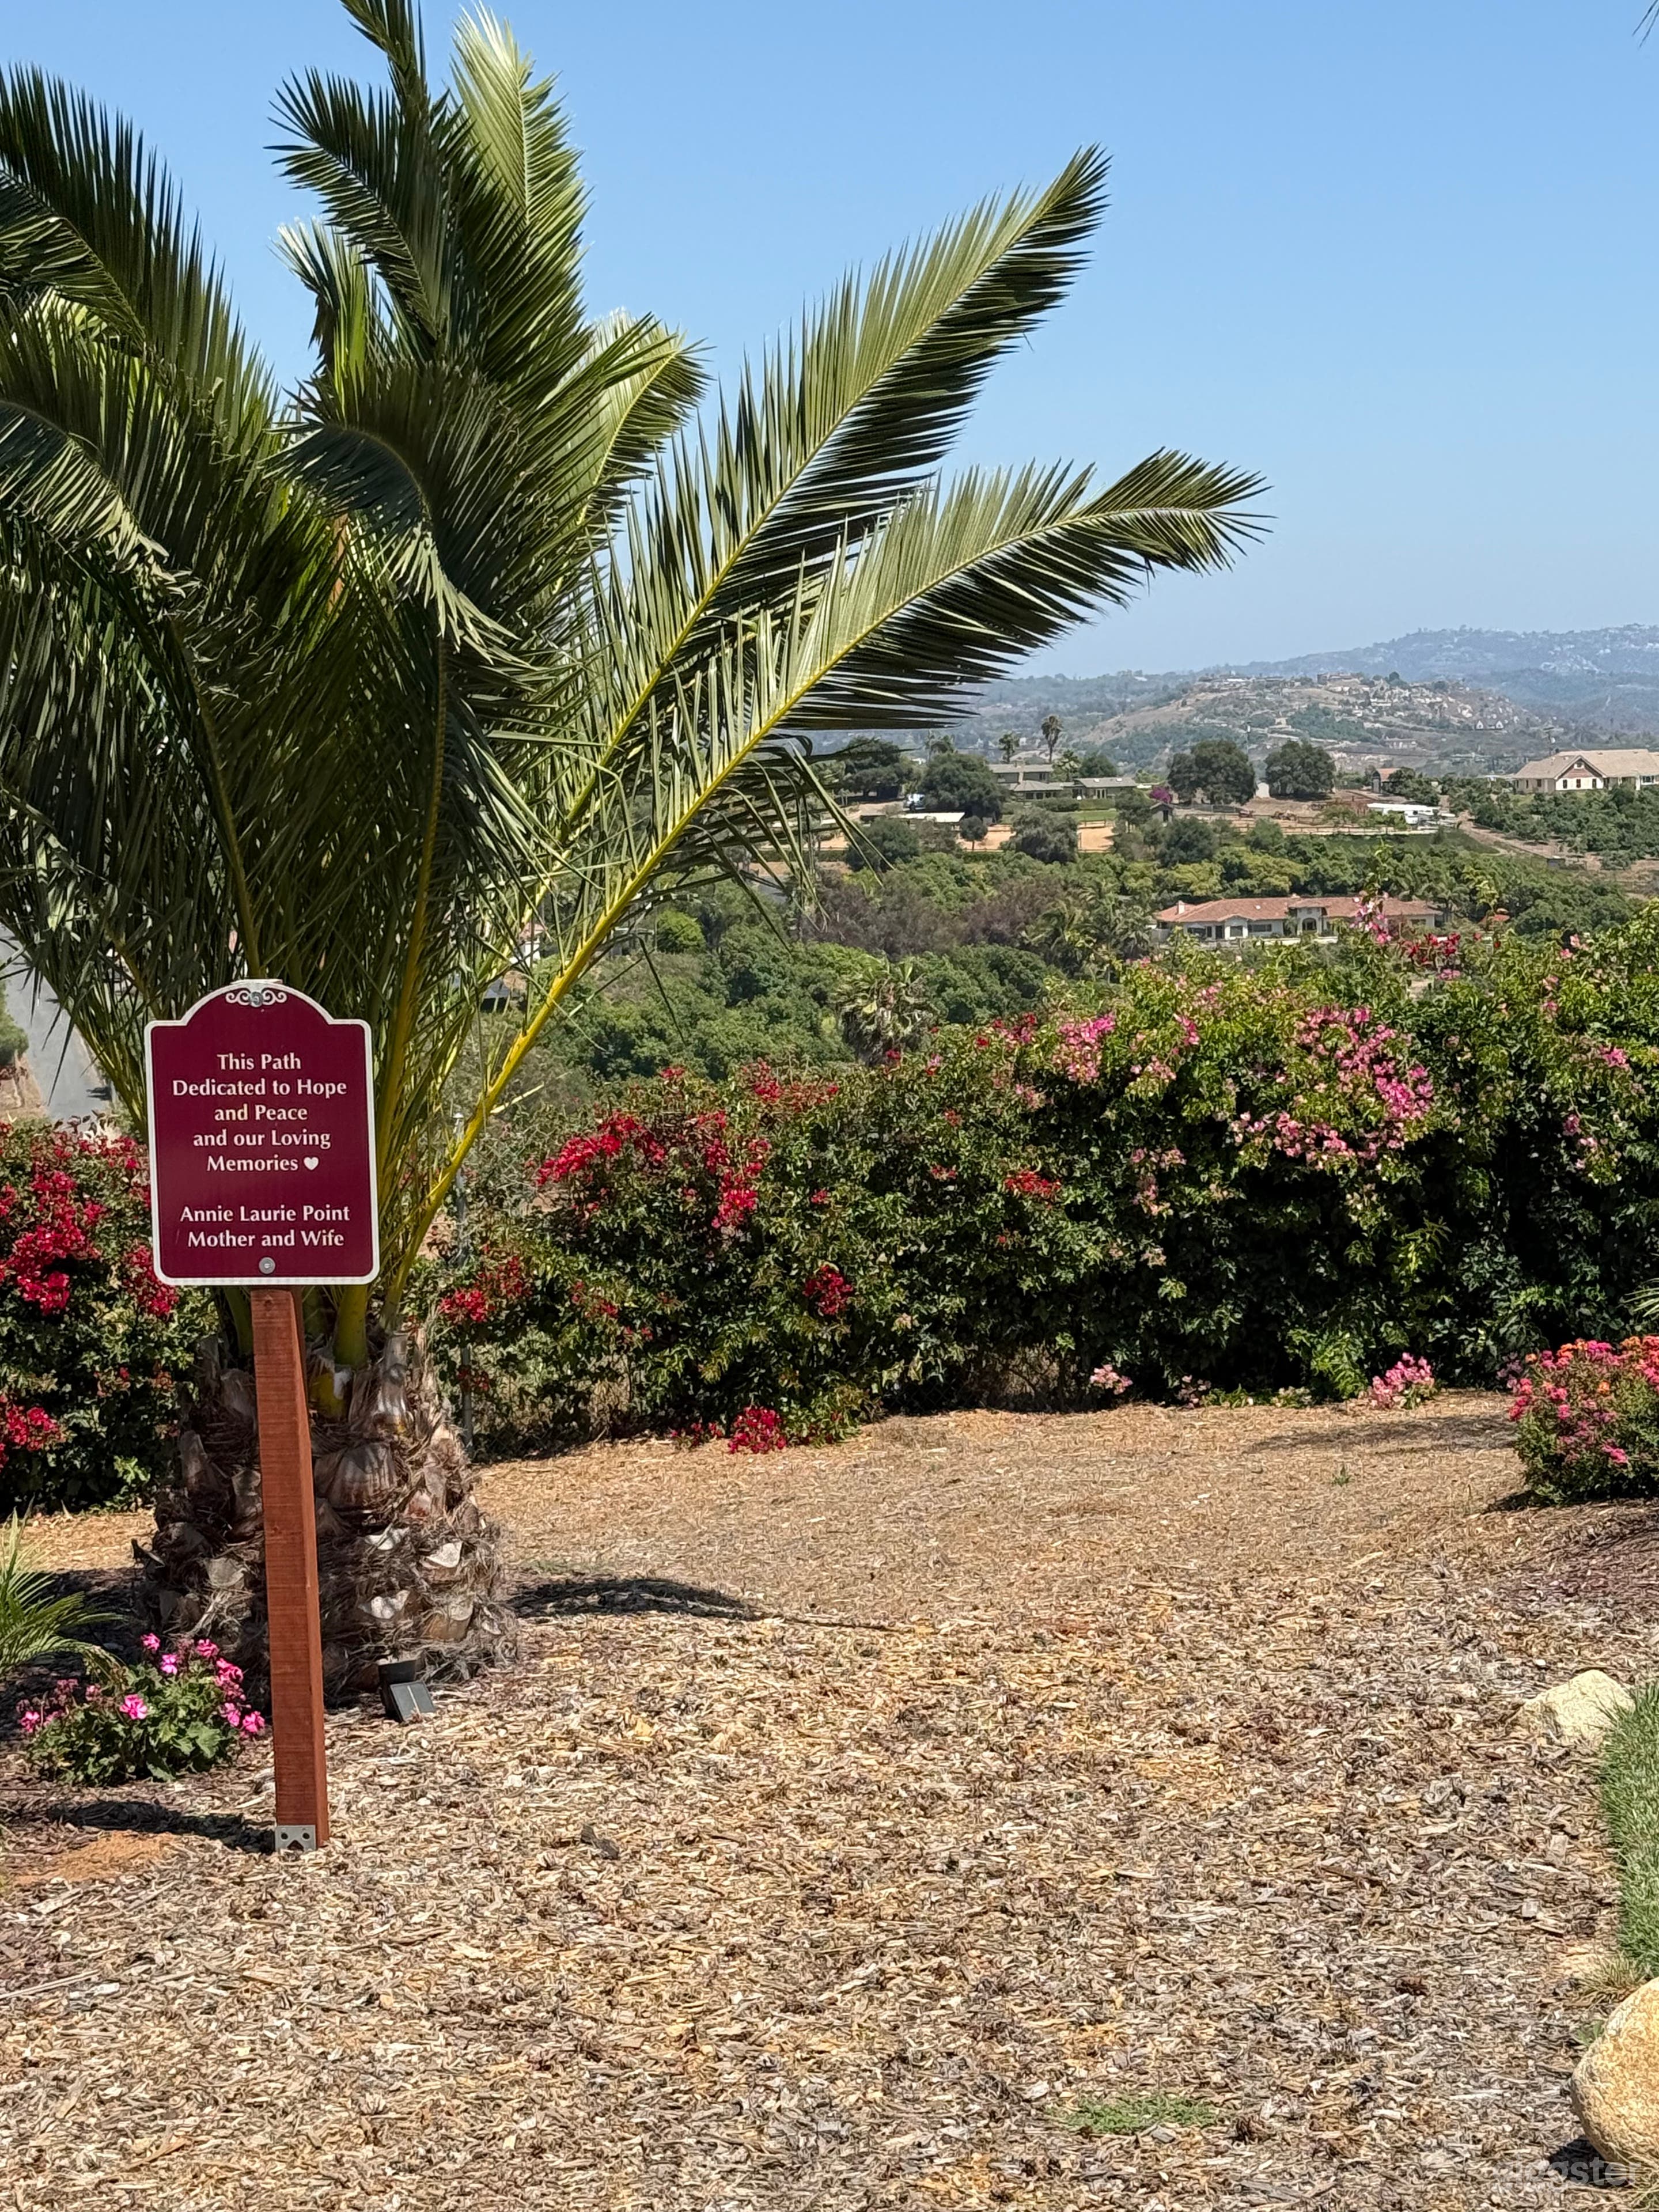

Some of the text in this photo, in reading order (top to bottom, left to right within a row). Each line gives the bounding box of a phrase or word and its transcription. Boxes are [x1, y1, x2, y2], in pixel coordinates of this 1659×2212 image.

[217, 1052, 301, 1070] This Path
[172, 1078, 347, 1099] Dedicated to Hope
[214, 1103, 308, 1121] and Peace
[193, 1128, 331, 1149] and our Loving
[207, 1154, 298, 1172] Memories
[180, 1204, 350, 1222] Annie Laurie Point
[188, 1229, 344, 1247] Mother and Wife
